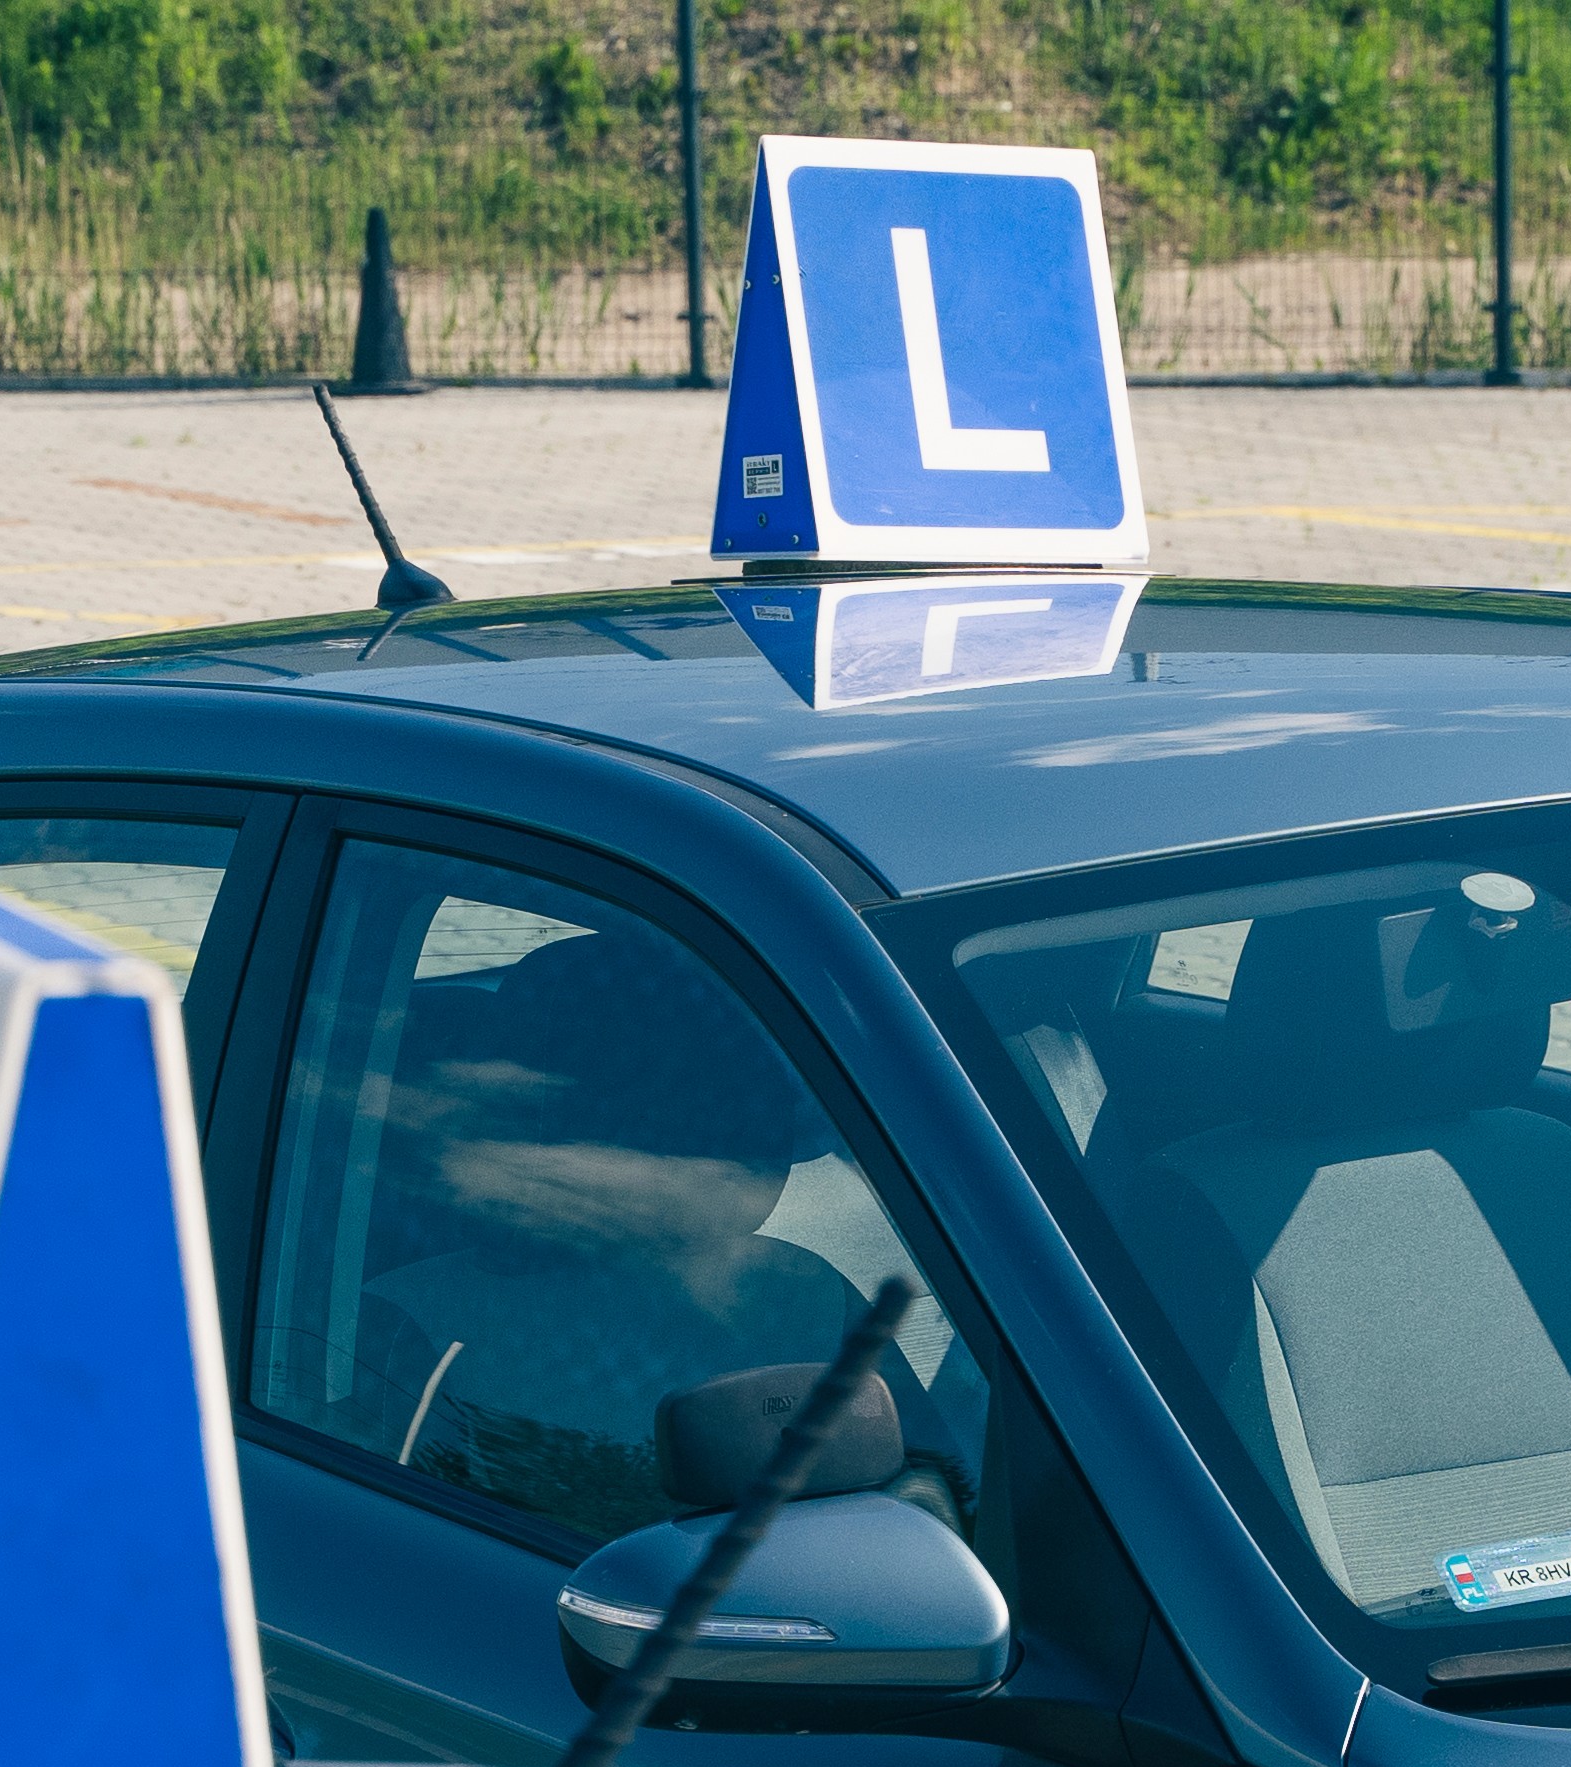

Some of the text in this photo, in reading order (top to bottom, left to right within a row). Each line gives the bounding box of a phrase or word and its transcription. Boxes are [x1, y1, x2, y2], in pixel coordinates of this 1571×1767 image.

[890, 227, 1051, 472] L
[1503, 1568, 1535, 1587] KR
[1461, 1586, 1484, 1599] PL
